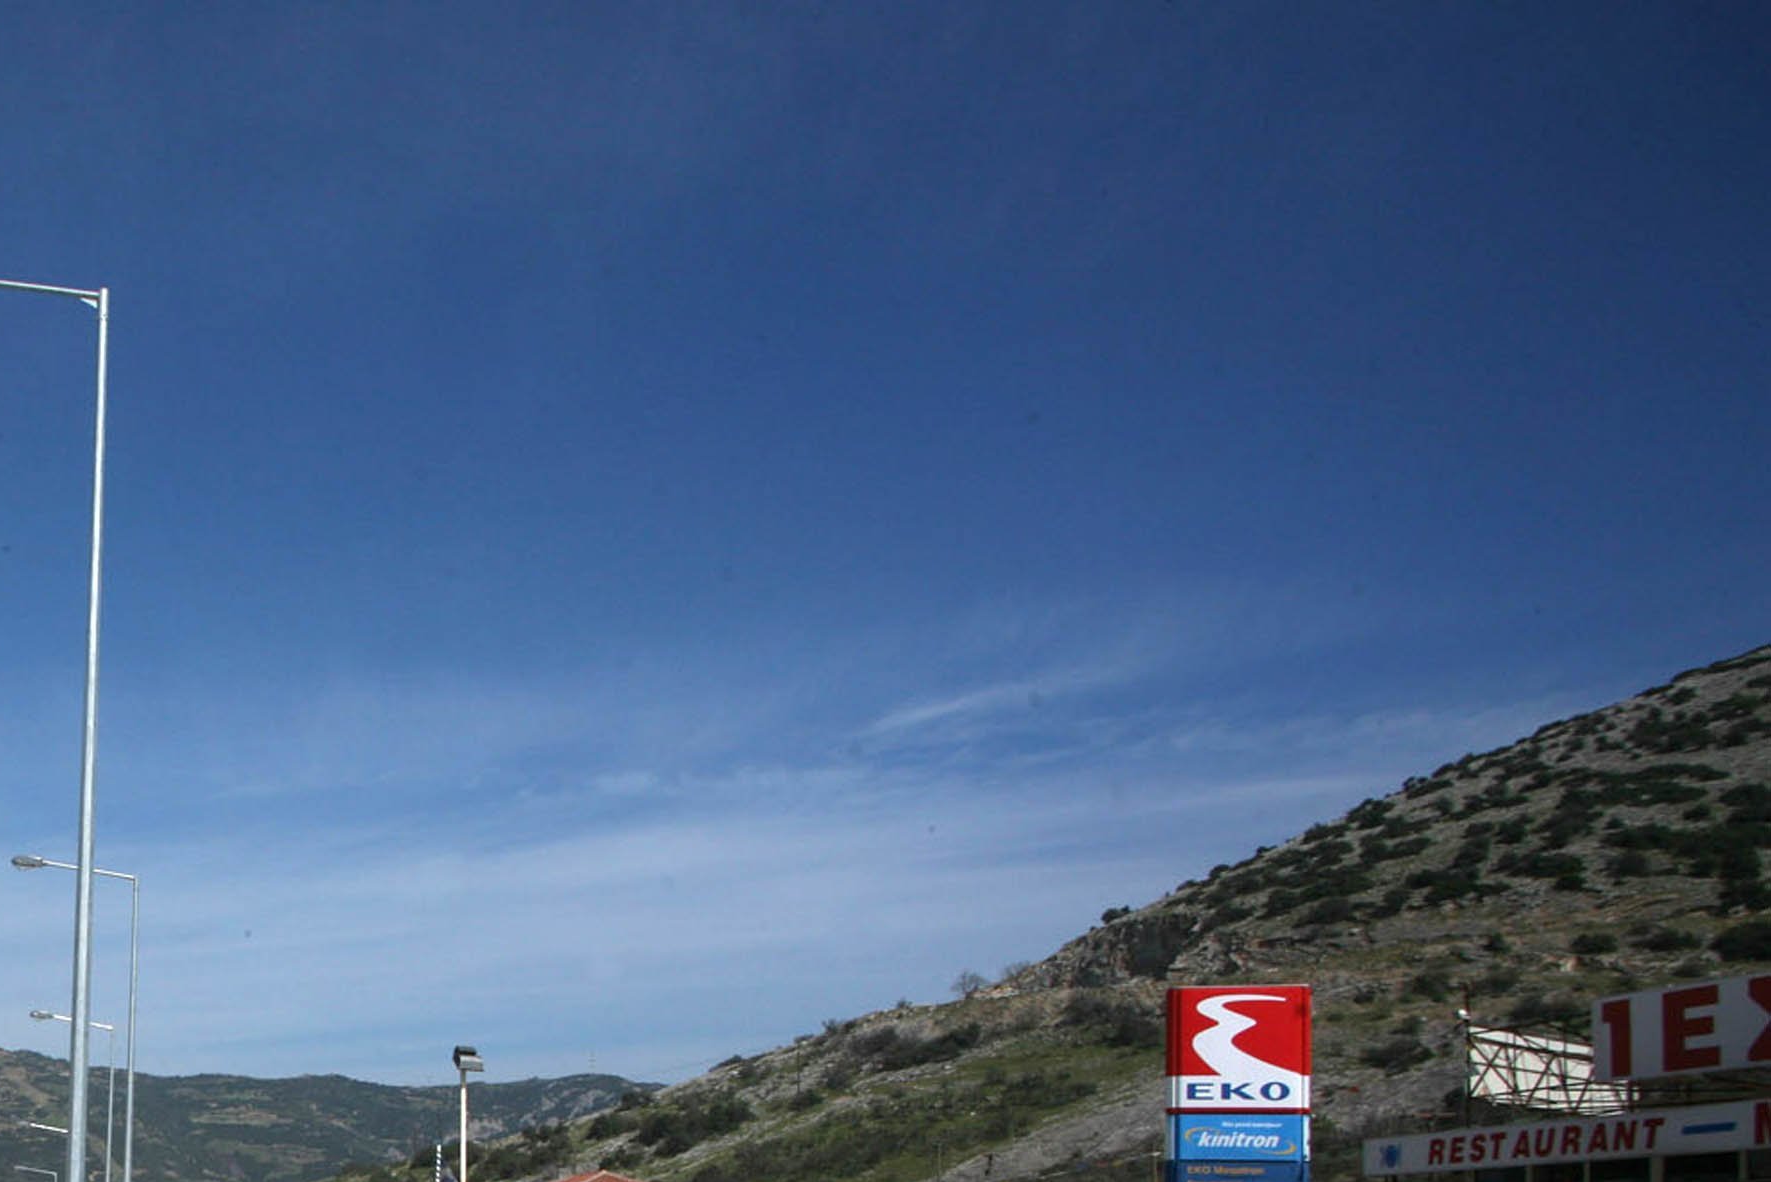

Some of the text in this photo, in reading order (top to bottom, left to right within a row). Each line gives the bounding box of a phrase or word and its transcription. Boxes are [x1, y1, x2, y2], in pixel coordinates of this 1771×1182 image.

[1186, 1082, 1290, 1101] EKO
[1198, 1131, 1280, 1148] kinitron
[1428, 1118, 1665, 1166] RESTAURANT
